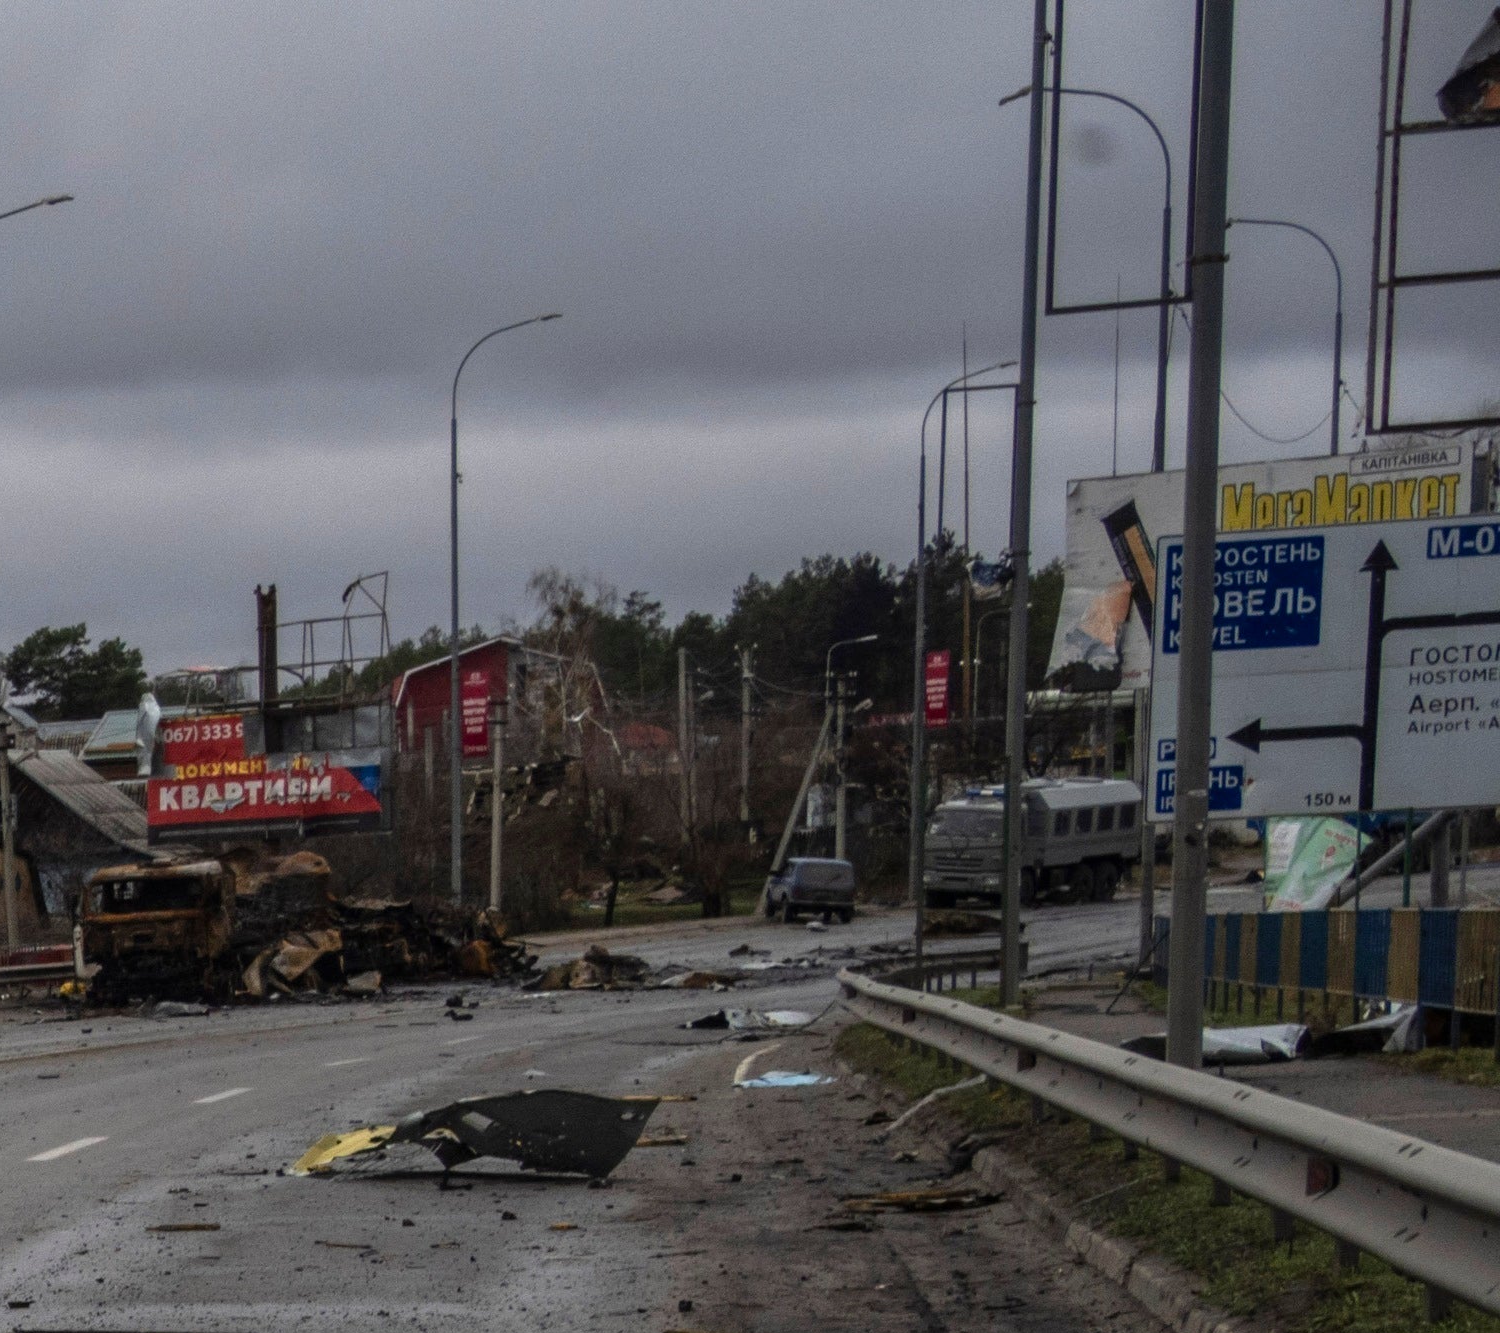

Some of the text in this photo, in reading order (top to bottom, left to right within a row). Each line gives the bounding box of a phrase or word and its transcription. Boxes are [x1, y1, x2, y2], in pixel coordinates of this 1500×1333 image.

[1361, 450, 1448, 470] КАПІТАНІВКА
[1430, 525, 1500, 557] М-0
[1171, 542, 1322, 572] КОСТЕНЬ
[1171, 568, 1269, 590] KOSTEN
[1169, 625, 1247, 649] KEL
[1410, 643, 1500, 667] ГОСТО
[1408, 667, 1500, 686] HOSTOME
[1408, 694, 1480, 718] Аерп.
[202, 723, 233, 740] 333
[1407, 716, 1471, 737] Airport
[1161, 769, 1239, 791] ІРНЬ
[1305, 792, 1334, 807] 150
